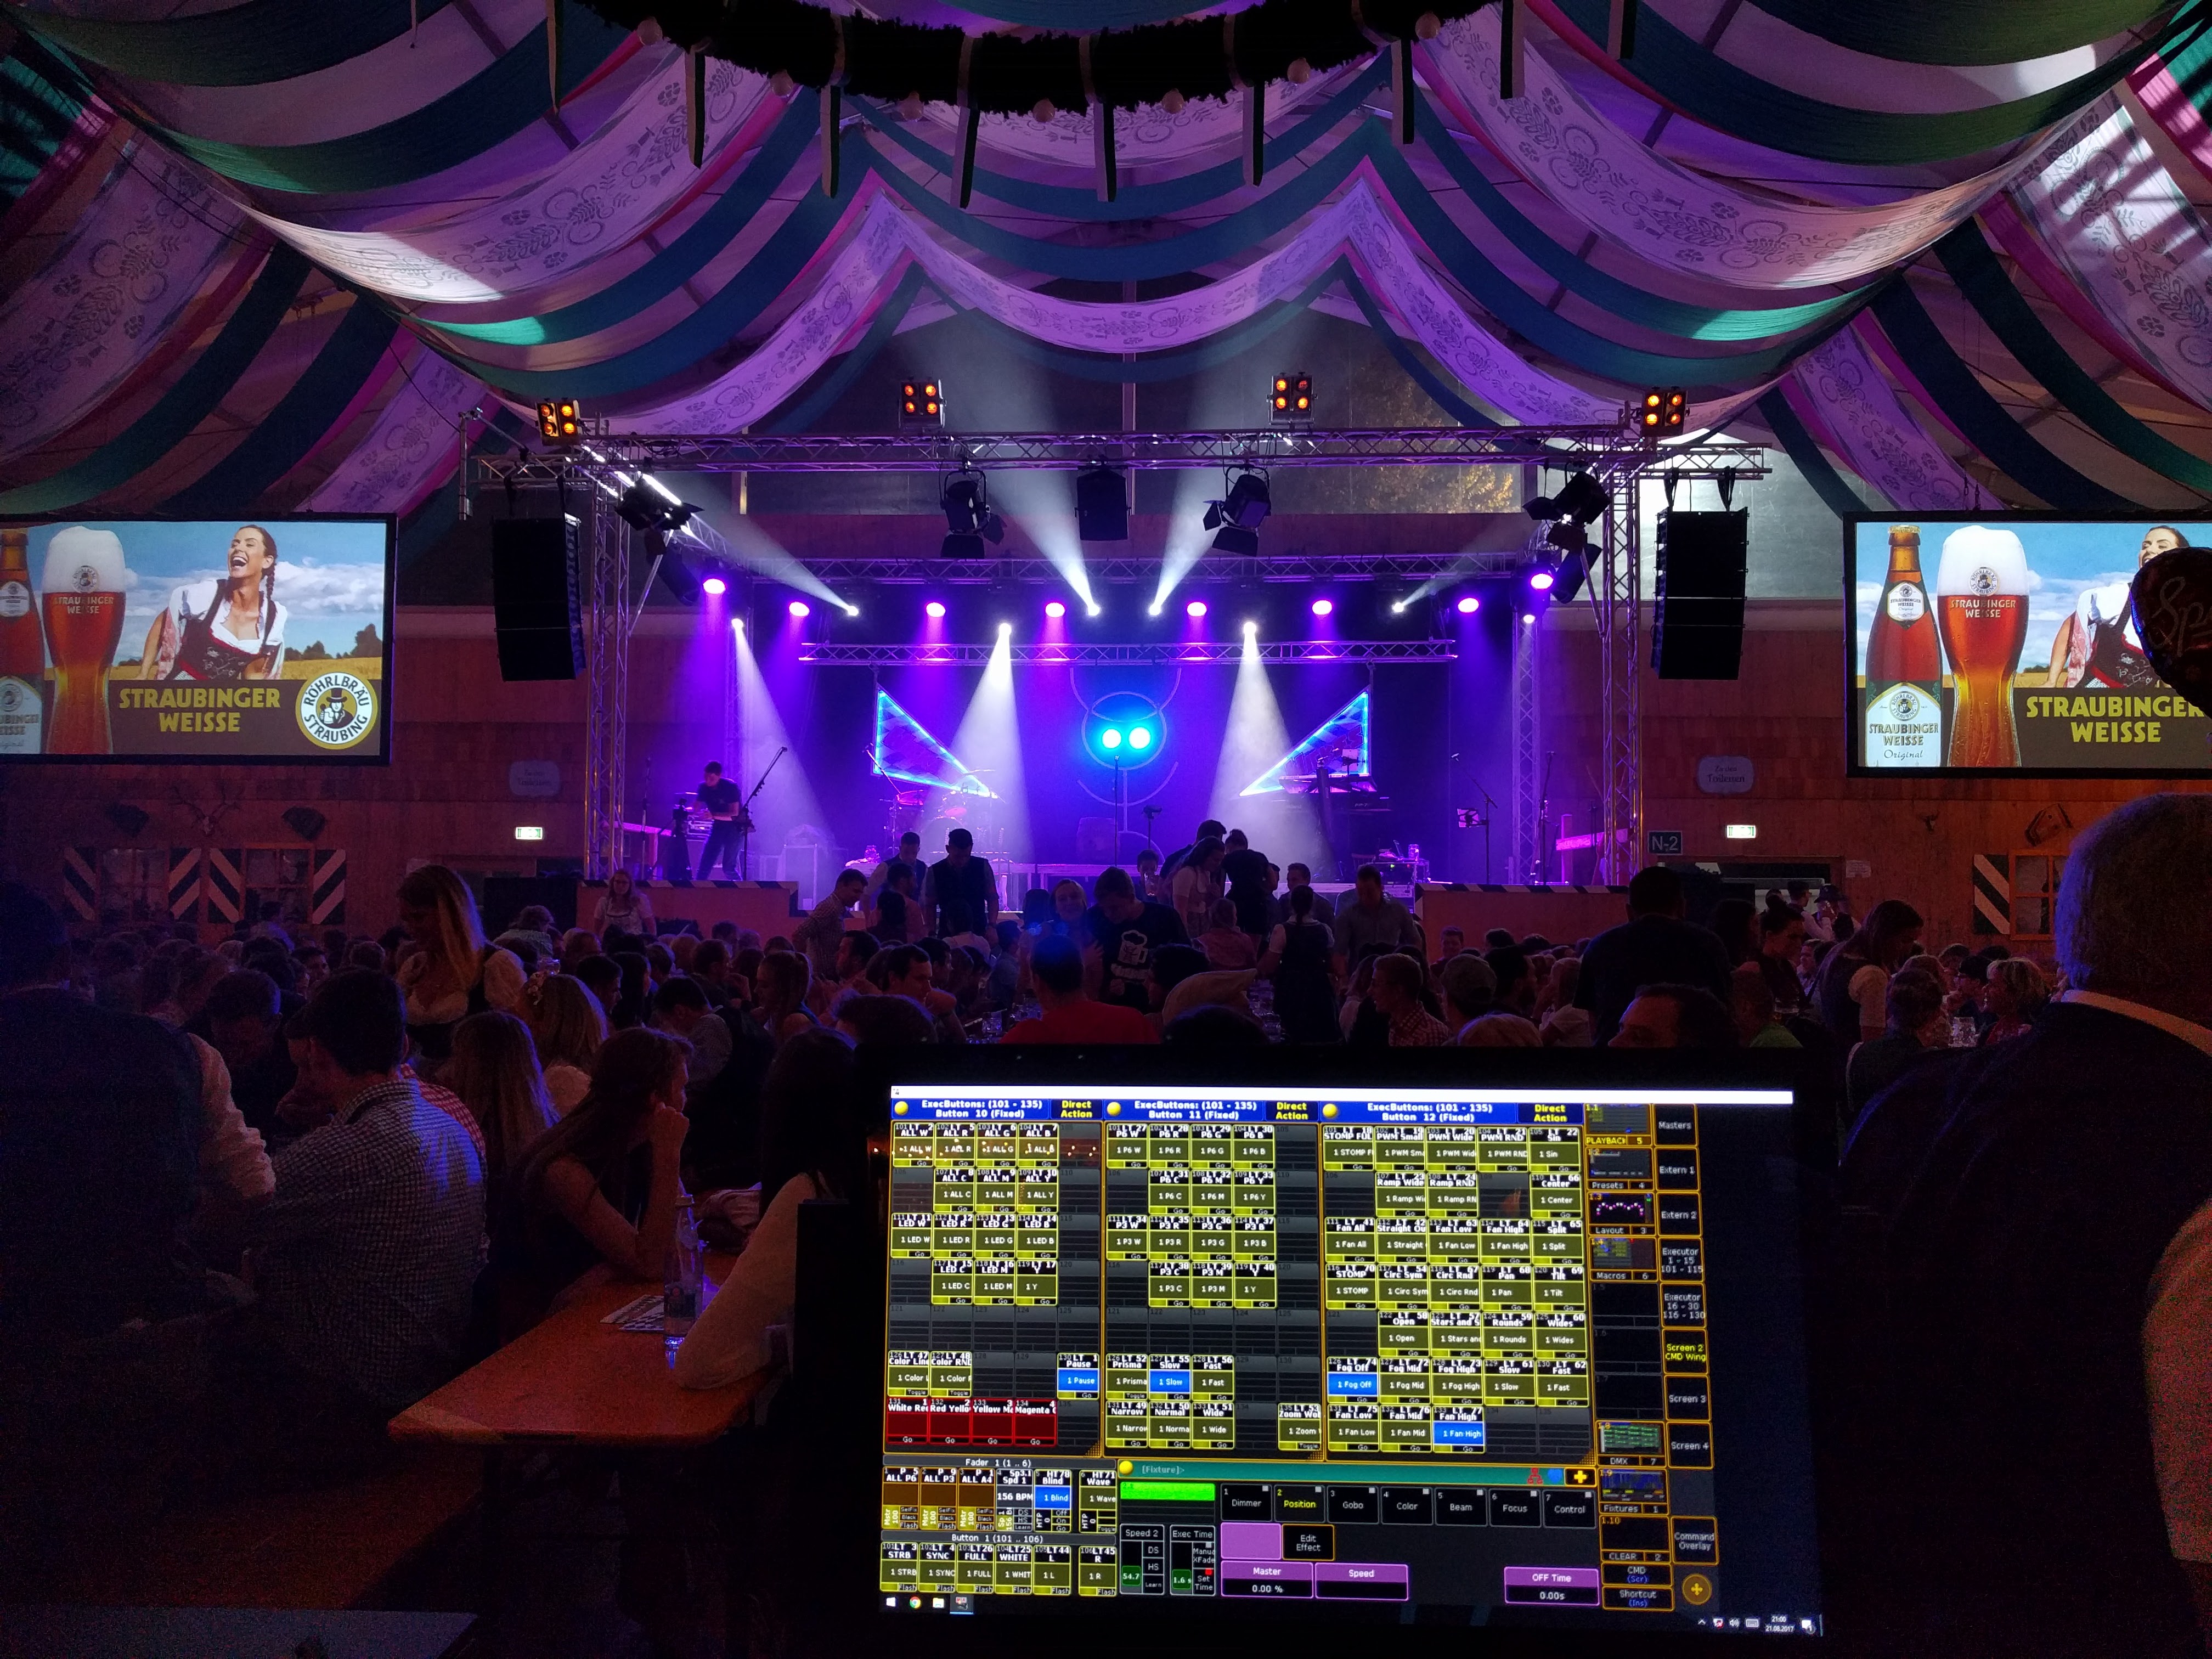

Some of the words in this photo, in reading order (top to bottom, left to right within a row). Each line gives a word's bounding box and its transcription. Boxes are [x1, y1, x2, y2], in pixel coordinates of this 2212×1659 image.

[303, 675, 369, 706] RÖHRLBRÄU
[119, 688, 280, 708] STRAUBINGER
[159, 712, 241, 732] WEISSE
[304, 714, 368, 742] STRAUBING
[1869, 723, 1938, 733] STRAUBINGER
[2071, 721, 2161, 742] WEISSE
[1883, 735, 1923, 746] WEISSE
[1884, 749, 1923, 761] Original
[1652, 836, 1678, 850] N-2
[922, 1100, 985, 1108] ExecButtons:
[988, 1101, 1009, 1109] (101
[1021, 1101, 1042, 1109] 135)
[1202, 1101, 1223, 1110] (101
[1235, 1102, 1256, 1111] 135)
[1436, 1104, 1458, 1113] (101
[1470, 1104, 1492, 1113] 135)
[1534, 1104, 1565, 1113] Direct
[991, 1110, 1024, 1119] (Fixed)
[1205, 1111, 1239, 1120] (Fixed)
[1440, 1114, 1475, 1122] (Fixed)
[1686, 1353, 1706, 1361] Wing
[1015, 1407, 1049, 1415] Magenta
[1003, 1459, 1011, 1468] (1
[1554, 1505, 1585, 1514] Control
[993, 1535, 1012, 1543] (101
[1679, 1542, 1711, 1551] Overlay
[1348, 1570, 1374, 1578] Speed
[1628, 1575, 1647, 1583] (Scr)
[1620, 1590, 1656, 1598] Shortcut
[1629, 1599, 1647, 1607] (Ins)
